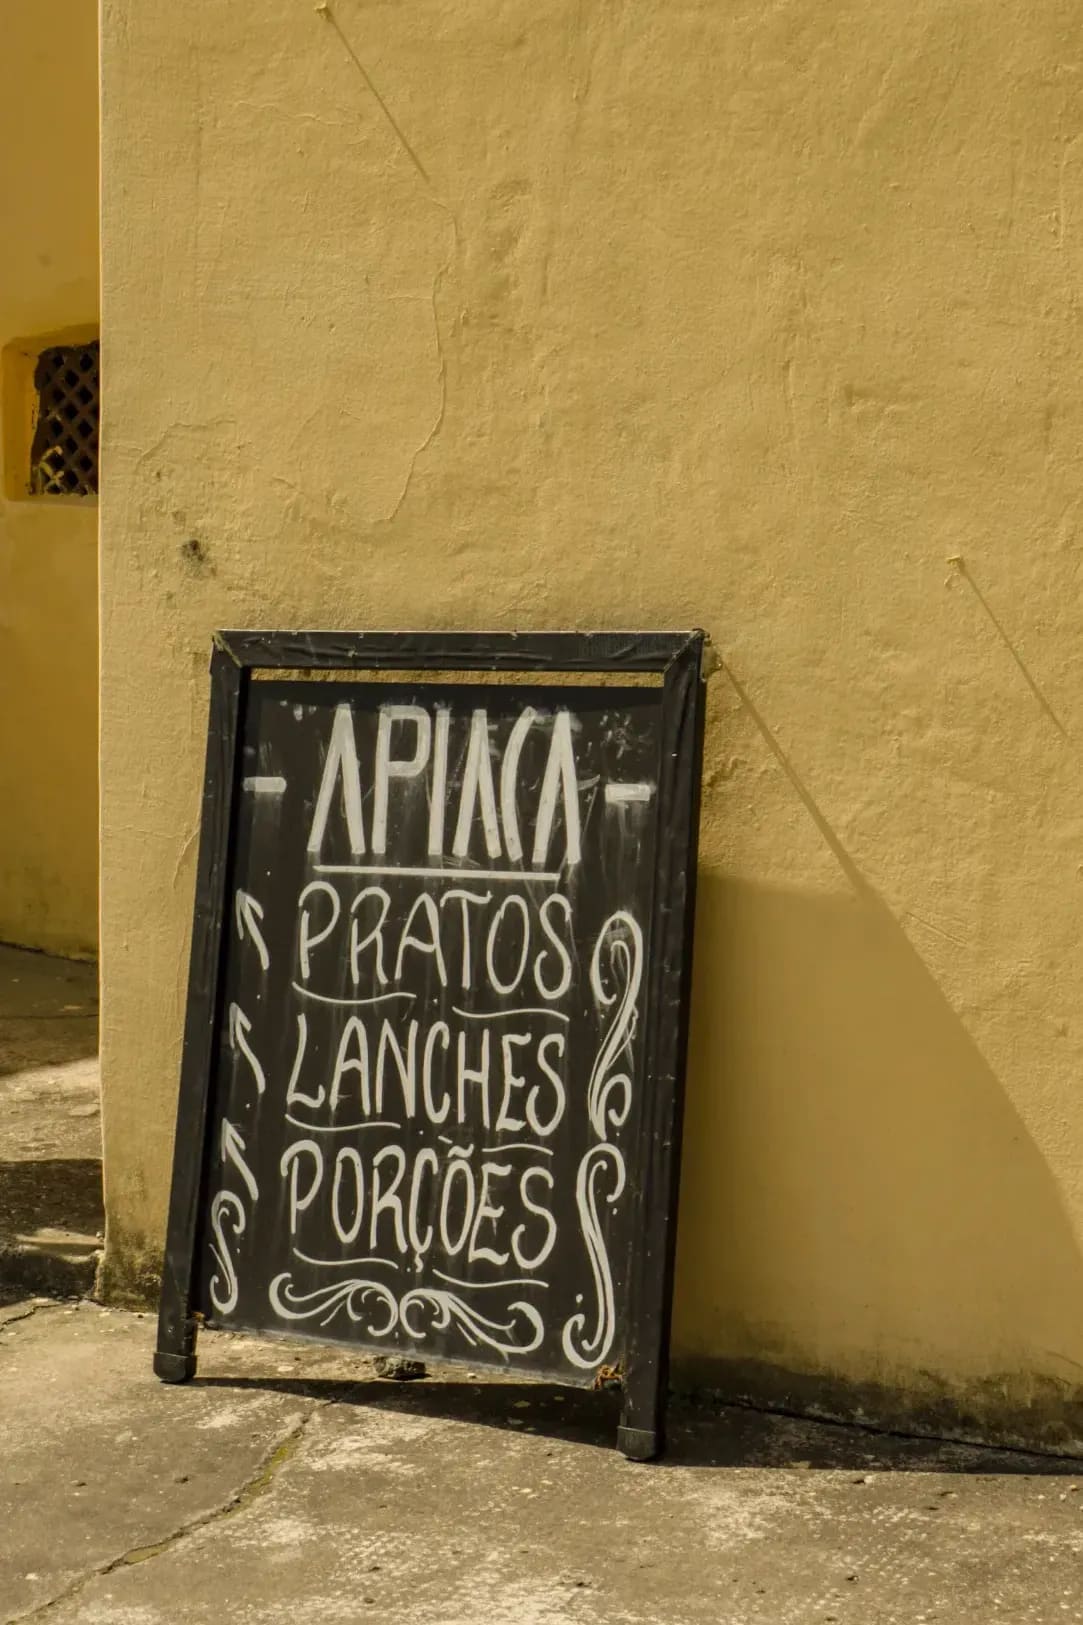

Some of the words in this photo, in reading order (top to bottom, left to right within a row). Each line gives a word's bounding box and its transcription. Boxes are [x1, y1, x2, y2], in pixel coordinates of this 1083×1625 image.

[298, 880, 572, 999] PRATOS
[286, 1013, 565, 1136] LANCHES
[280, 1140, 557, 1273] PORÇÕES
